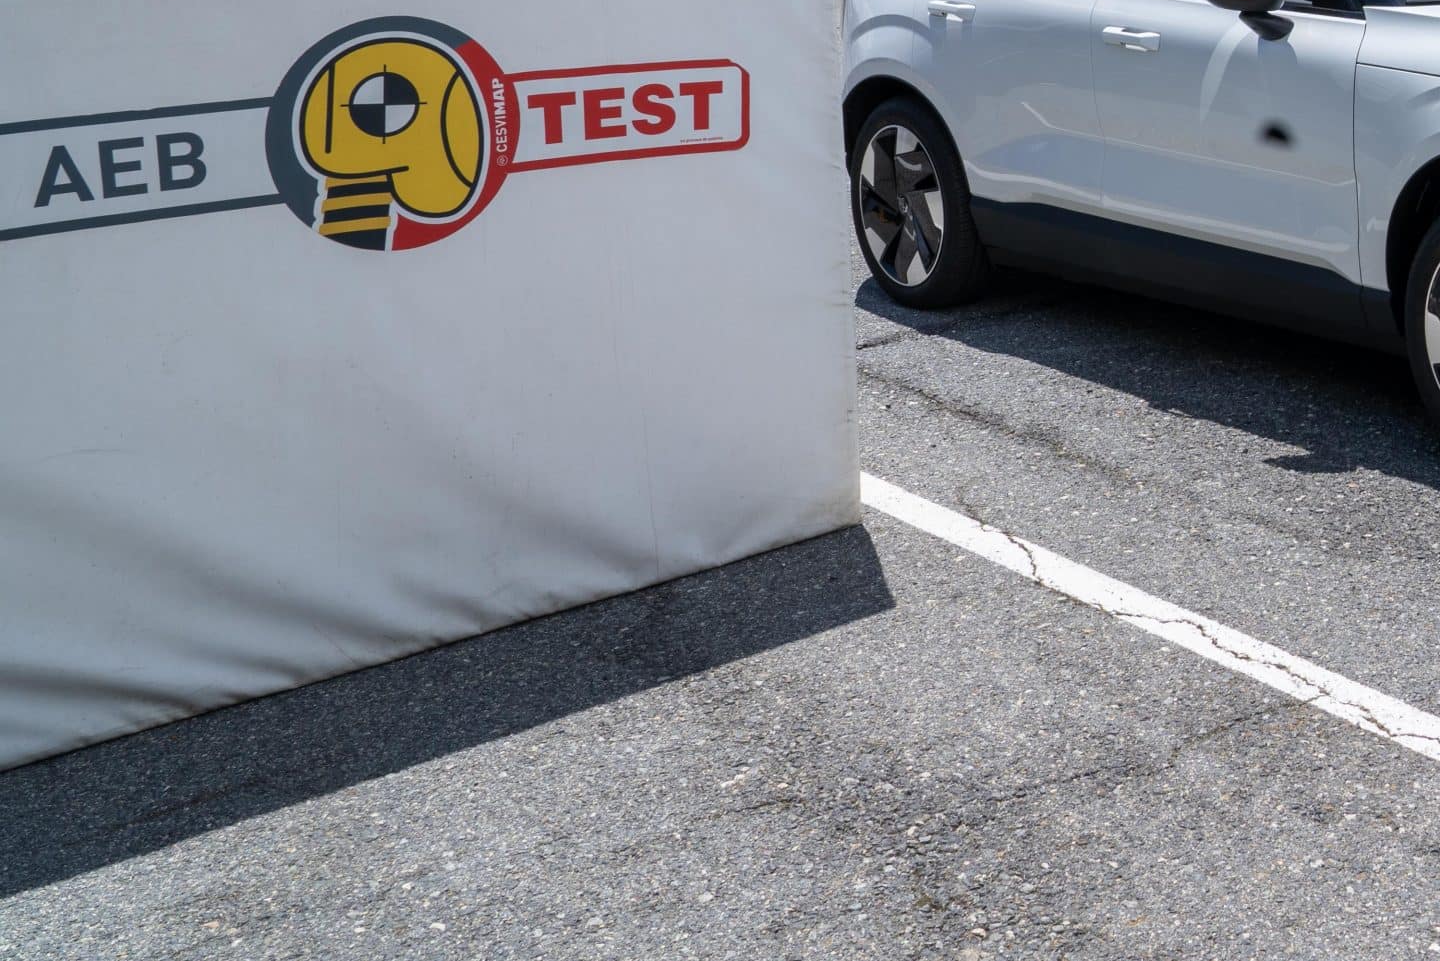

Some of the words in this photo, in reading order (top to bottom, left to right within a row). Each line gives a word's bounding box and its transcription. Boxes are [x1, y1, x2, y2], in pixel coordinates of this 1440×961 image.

[34, 132, 207, 208] AEB
[527, 80, 723, 144] TEST
[491, 77, 508, 153] CESVIMAP
